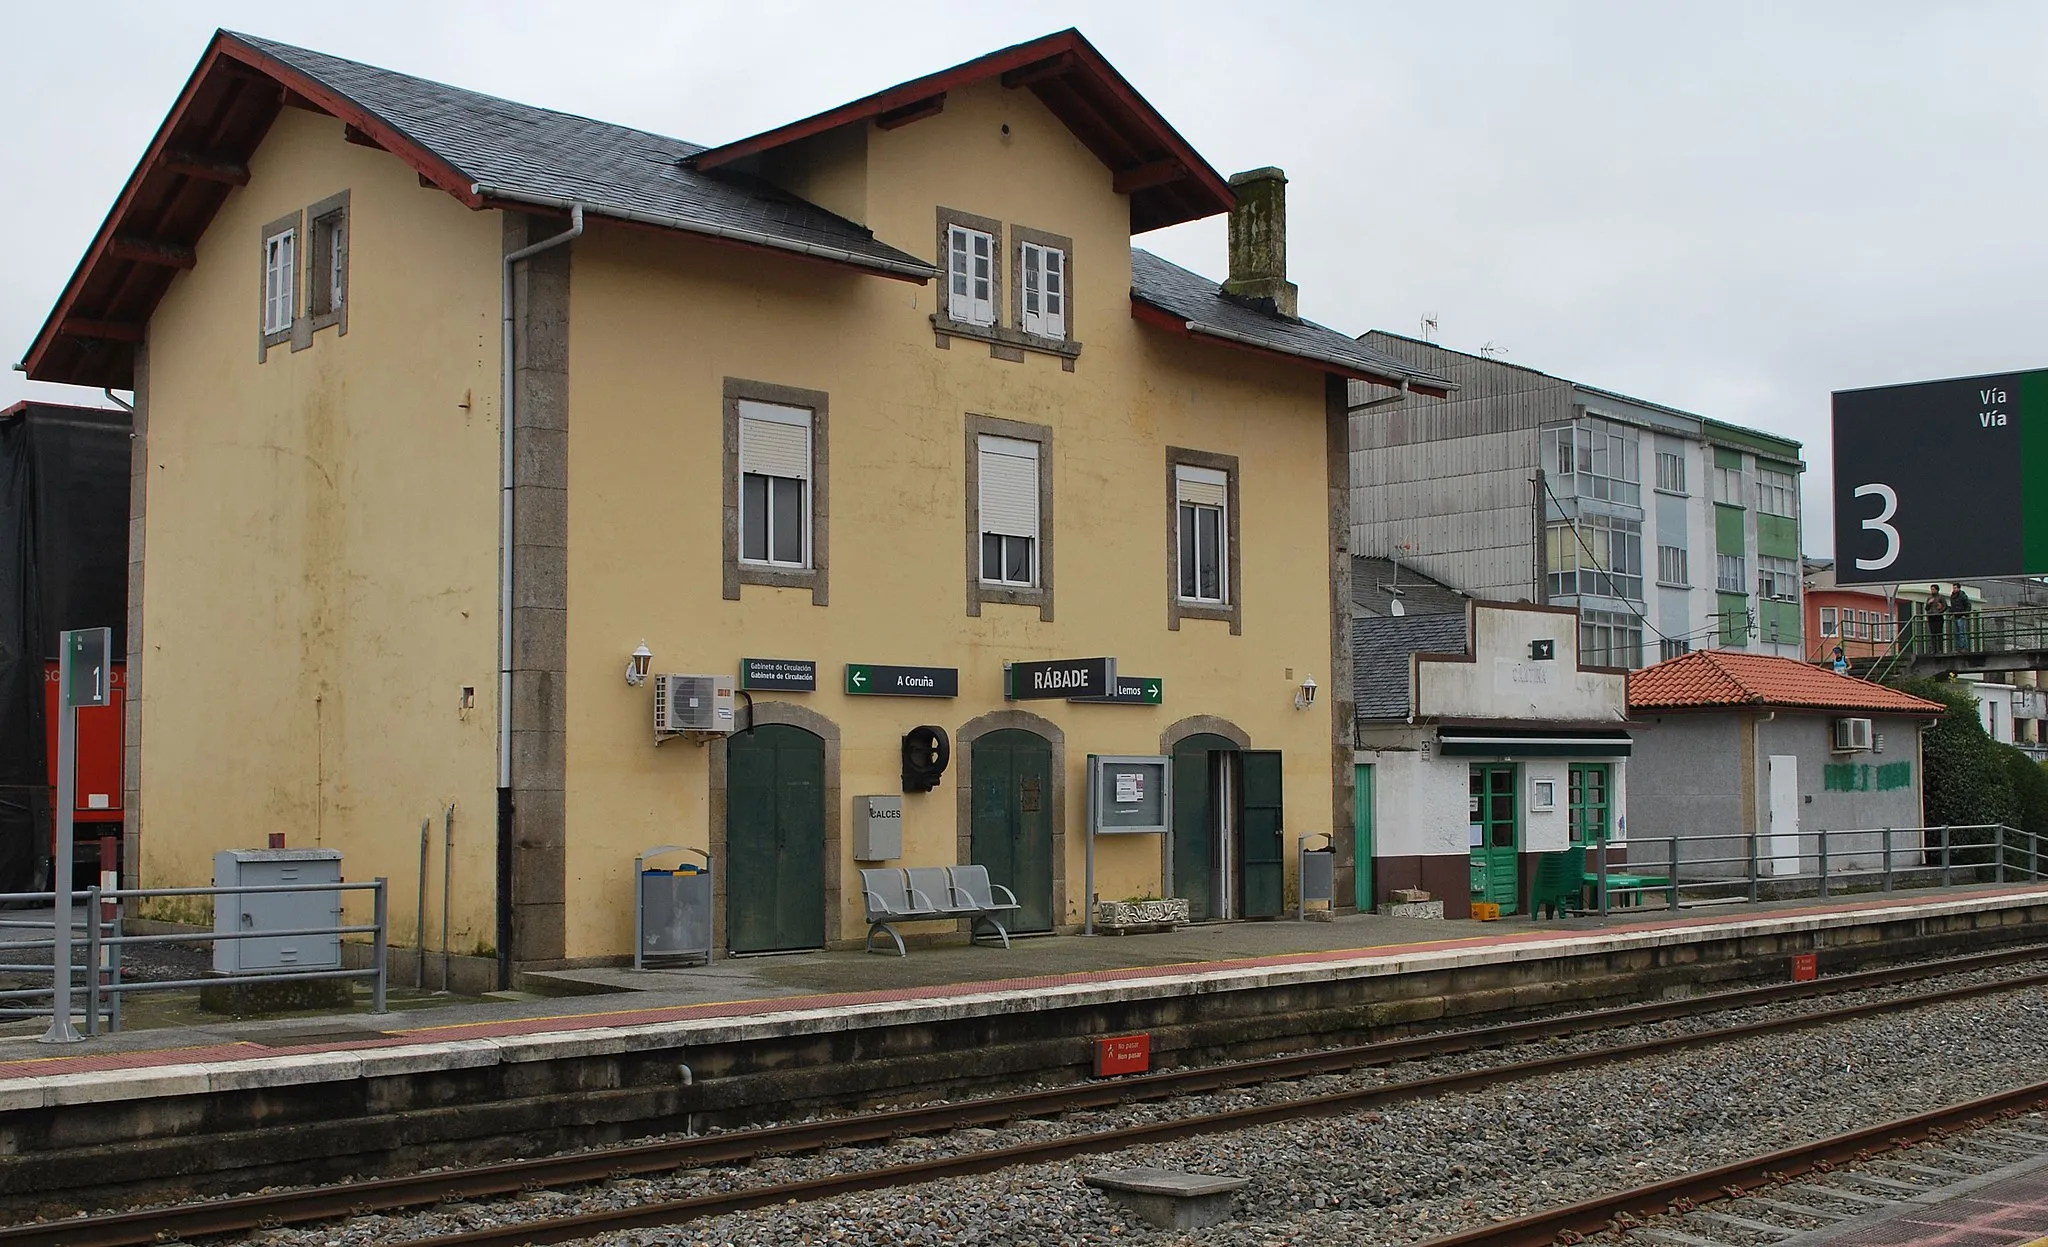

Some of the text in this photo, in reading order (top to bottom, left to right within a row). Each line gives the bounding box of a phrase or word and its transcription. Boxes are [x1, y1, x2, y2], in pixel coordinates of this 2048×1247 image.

[1979, 387, 2007, 405] Vía
[1979, 410, 2008, 428] Vía
[1853, 483, 1901, 571] 3
[750, 662, 811, 672] Gabinete de Circulación
[93, 665, 102, 701] 1
[750, 671, 813, 681] Gabinete de Circulación
[897, 675, 934, 687] A Coruña
[1034, 667, 1089, 689] RÁBADE
[1118, 684, 1141, 696] Lemos
[870, 810, 901, 818] CALCES
